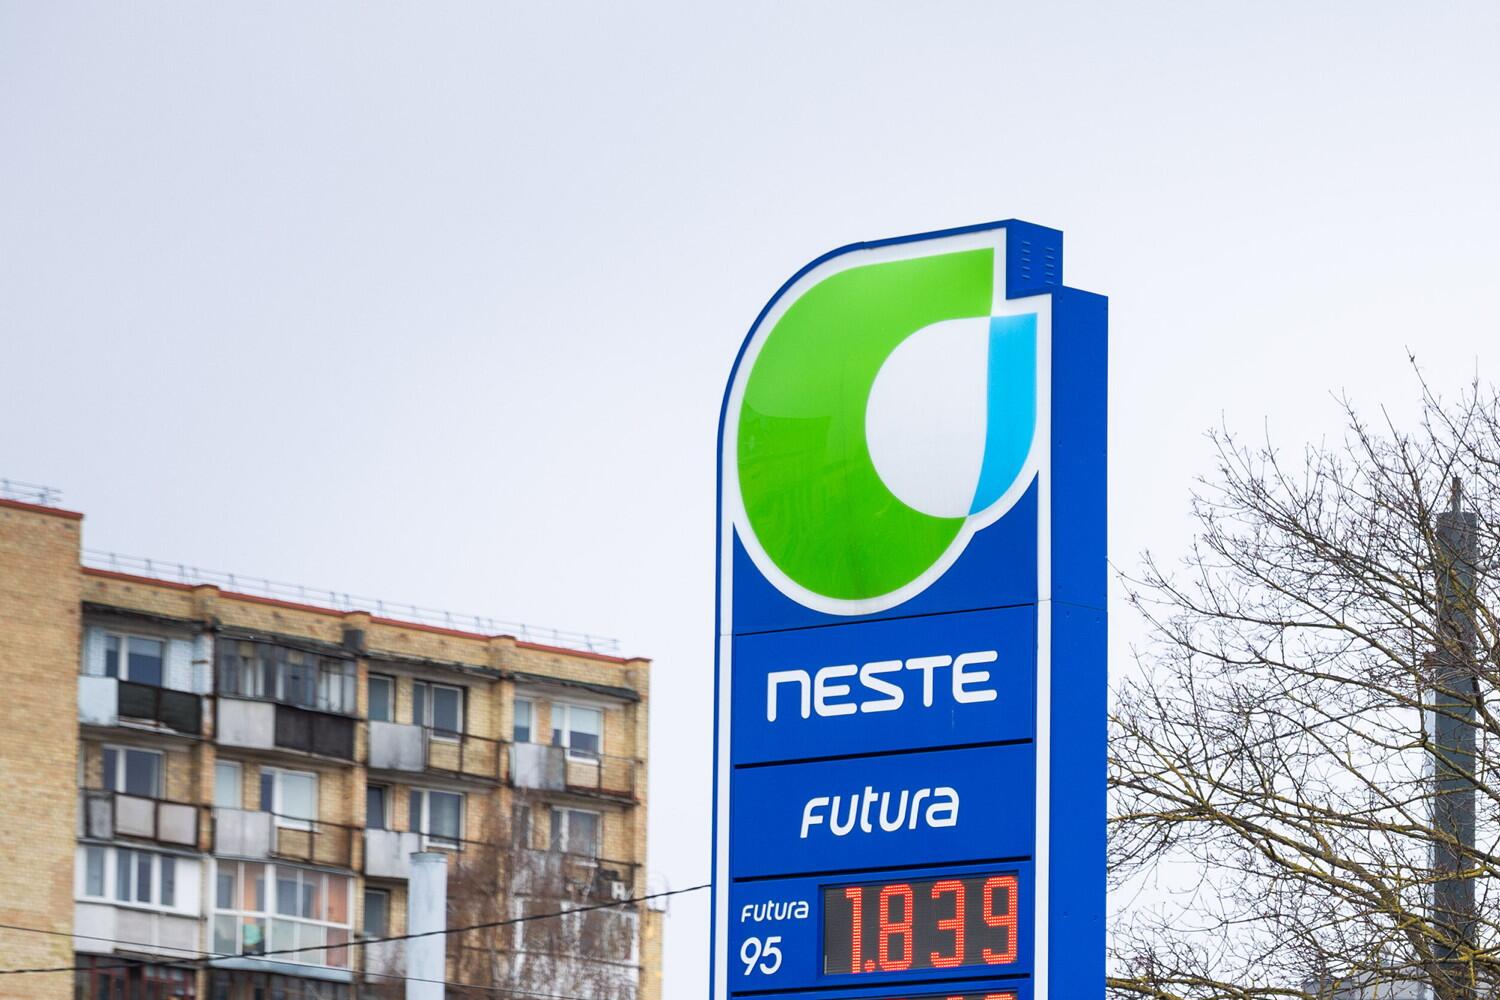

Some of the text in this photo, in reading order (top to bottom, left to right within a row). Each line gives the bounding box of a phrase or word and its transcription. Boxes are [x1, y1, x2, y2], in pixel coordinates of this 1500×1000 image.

[767, 650, 998, 722] NESTE
[800, 786, 960, 838] Futura
[741, 900, 809, 923] Futura
[846, 876, 1018, 974] 1.839
[740, 936, 782, 975] 95
